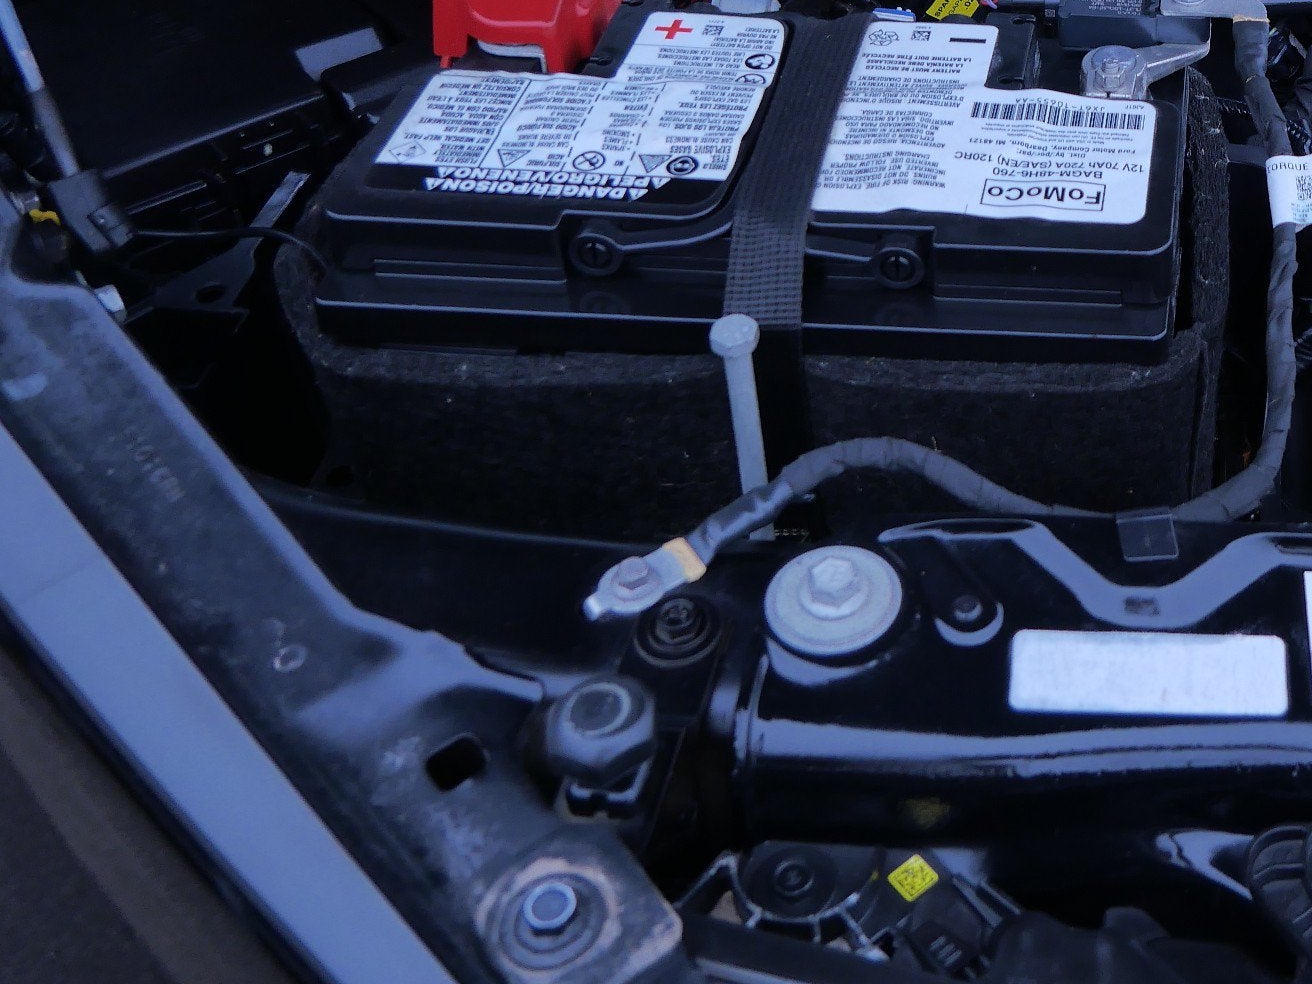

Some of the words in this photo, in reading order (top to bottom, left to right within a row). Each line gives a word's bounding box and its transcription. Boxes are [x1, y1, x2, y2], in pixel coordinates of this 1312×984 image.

[954, 151, 993, 163] 120RC
[997, 154, 1052, 170] (SAE/EN)
[1056, 161, 1084, 170] 720A
[1088, 161, 1119, 171] 70Ah
[1122, 163, 1144, 173] 12V
[1267, 162, 1308, 174] TORQUE
[449, 167, 651, 188] PELIGRO/VENENO
[992, 167, 1103, 179] BAGM-48H6-760
[439, 178, 627, 200] DANGER/POISON
[987, 186, 1103, 205] FoMoCo
